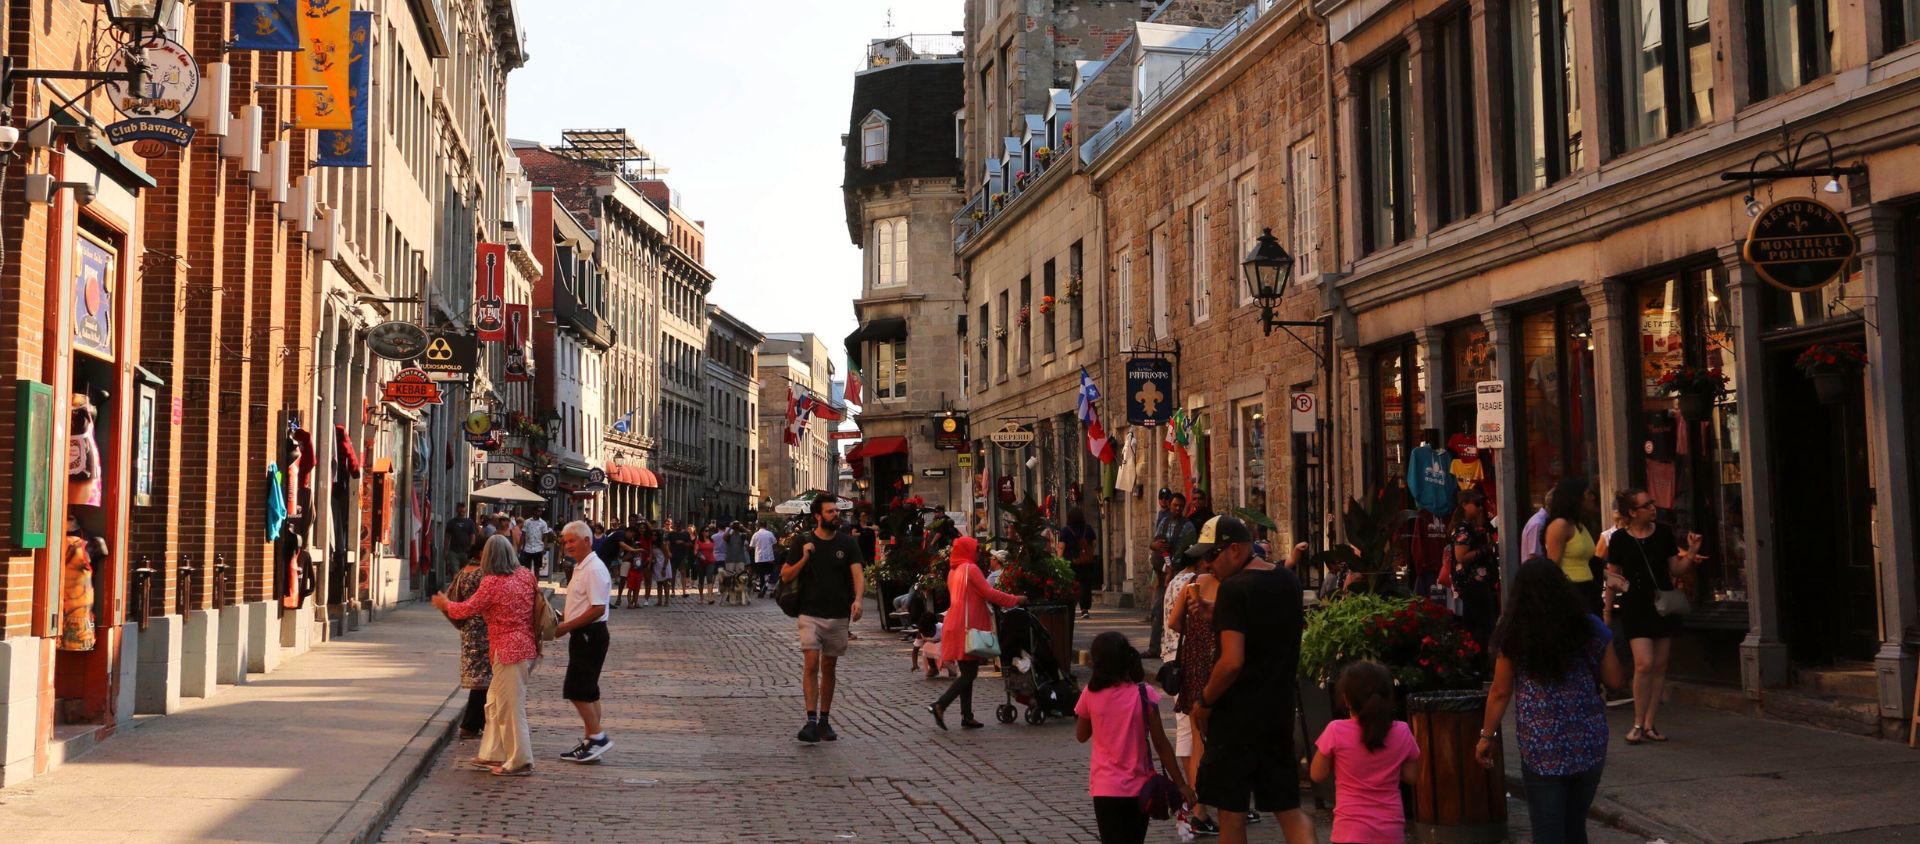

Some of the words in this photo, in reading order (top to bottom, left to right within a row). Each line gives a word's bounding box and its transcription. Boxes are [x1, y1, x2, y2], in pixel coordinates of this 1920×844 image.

[111, 122, 138, 137] Club
[139, 122, 189, 140] Bavarois
[139, 143, 160, 153] 140
[1762, 202, 1802, 229] RESTO
[1807, 204, 1833, 223] BAR
[1760, 237, 1842, 251] MONTREAL
[1769, 248, 1836, 260] POUTINE
[420, 363, 462, 371] TUDIOSAPOLLO
[396, 370, 427, 383] MONTREAL
[396, 384, 427, 395] KEBAB
[1478, 400, 1503, 411] TABAGIE
[1478, 433, 1503, 444] CUBAINS
